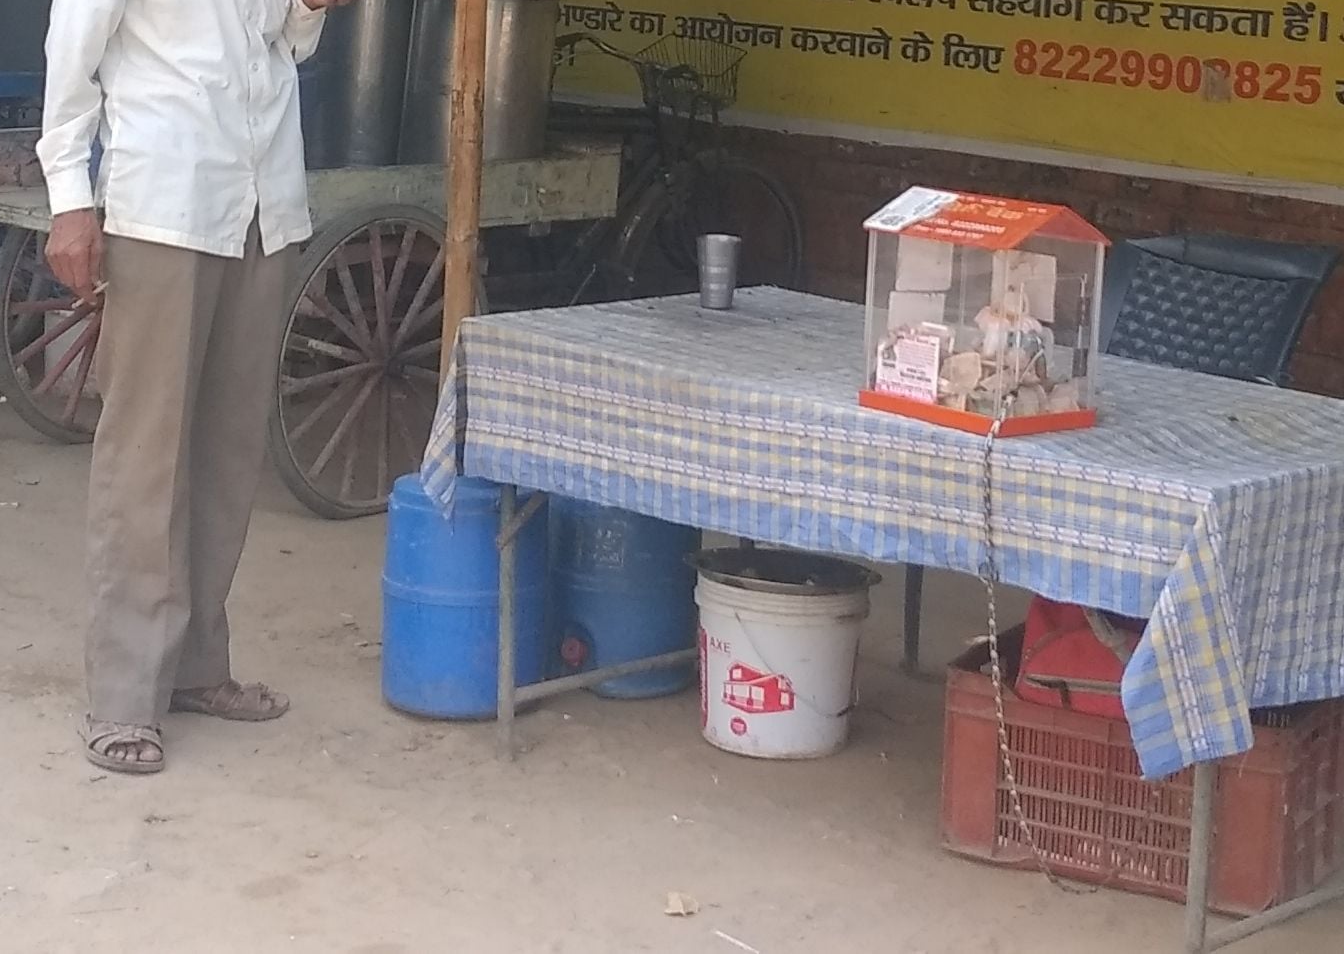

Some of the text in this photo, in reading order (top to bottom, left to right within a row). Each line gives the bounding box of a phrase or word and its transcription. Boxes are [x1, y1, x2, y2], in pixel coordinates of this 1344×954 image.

[1159, 2, 1274, 39] सकता
[629, 10, 667, 36] का
[673, 12, 784, 49] आयोजन
[790, 26, 893, 61] करवाने
[900, 30, 932, 64] के
[942, 34, 1005, 74] लिए
[709, 636, 731, 654] AXE
